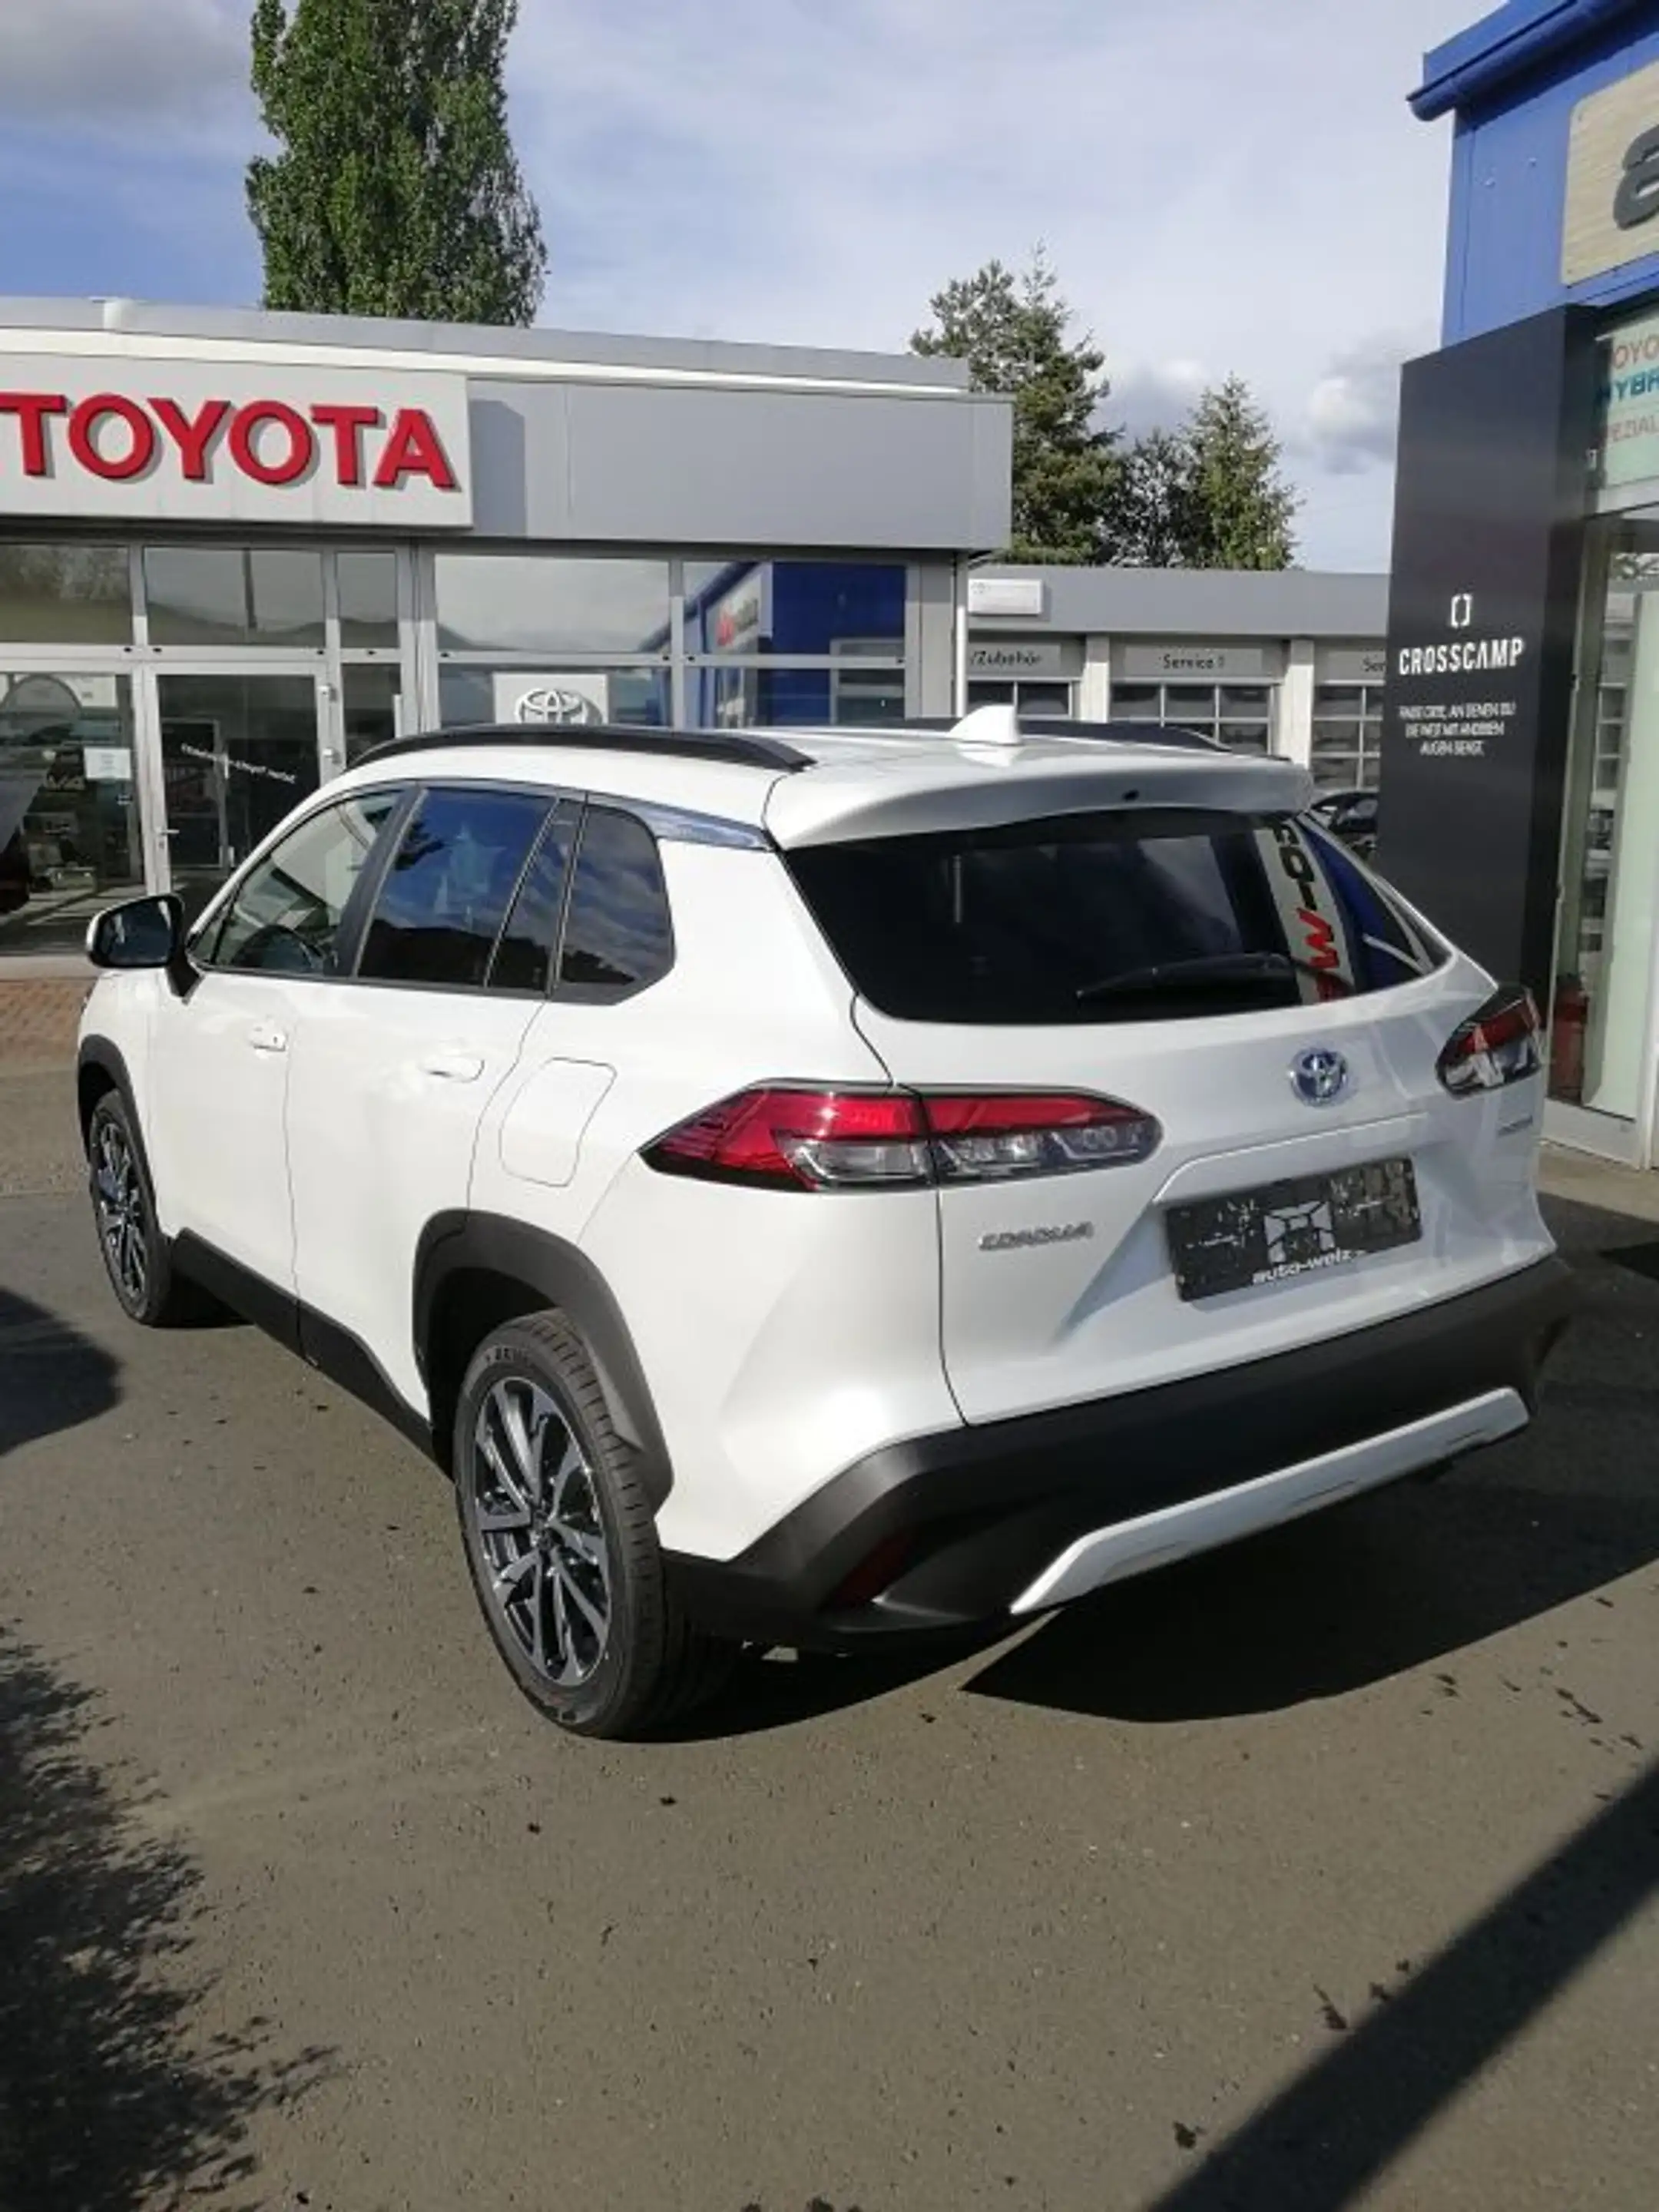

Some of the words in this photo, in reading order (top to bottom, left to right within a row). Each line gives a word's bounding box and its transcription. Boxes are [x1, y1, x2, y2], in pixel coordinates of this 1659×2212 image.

[0, 391, 456, 489] TOYOTA
[1163, 653, 1214, 670] Service
[1399, 637, 1524, 676] CROSSCAMP
